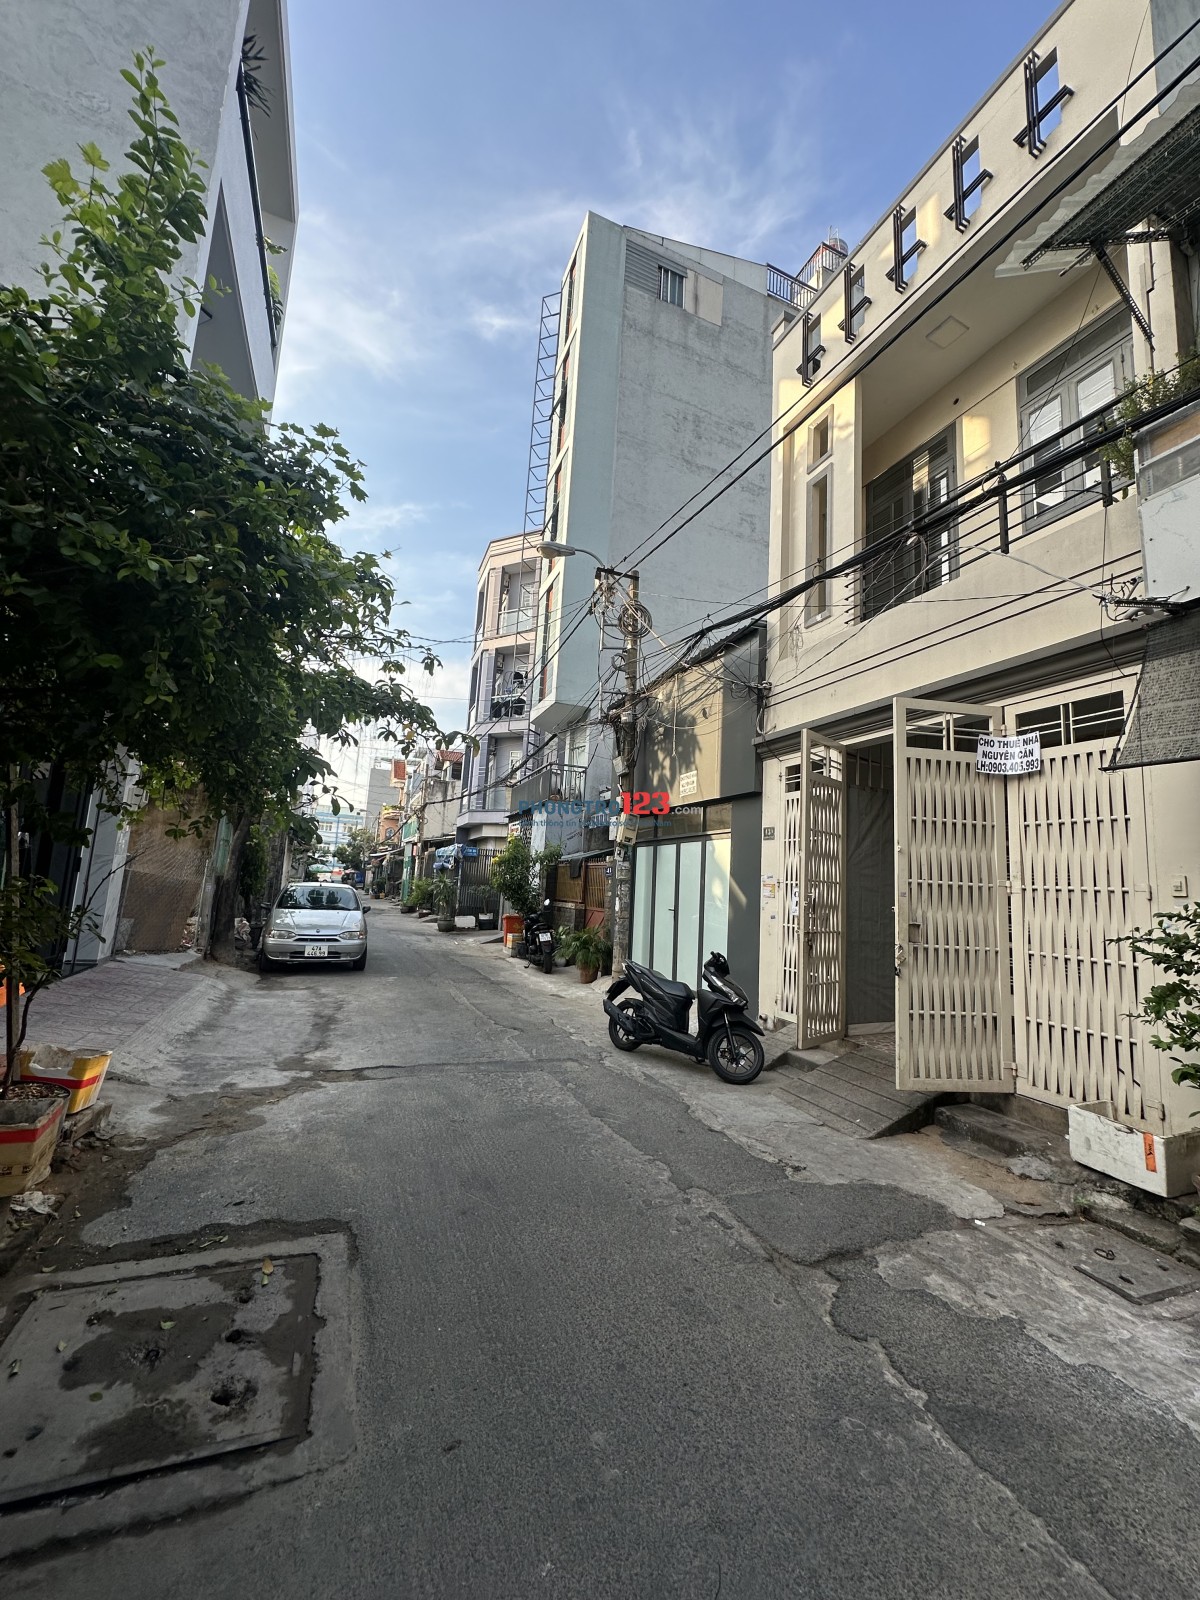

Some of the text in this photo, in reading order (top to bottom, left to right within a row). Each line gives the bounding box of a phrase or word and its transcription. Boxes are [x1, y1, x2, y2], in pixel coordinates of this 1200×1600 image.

[979, 738, 994, 748] CHO
[998, 738, 1020, 748] THUÊ
[982, 748, 1034, 760] NGUYÊN CĂN
[976, 758, 1038, 772] LH:0903.405.993
